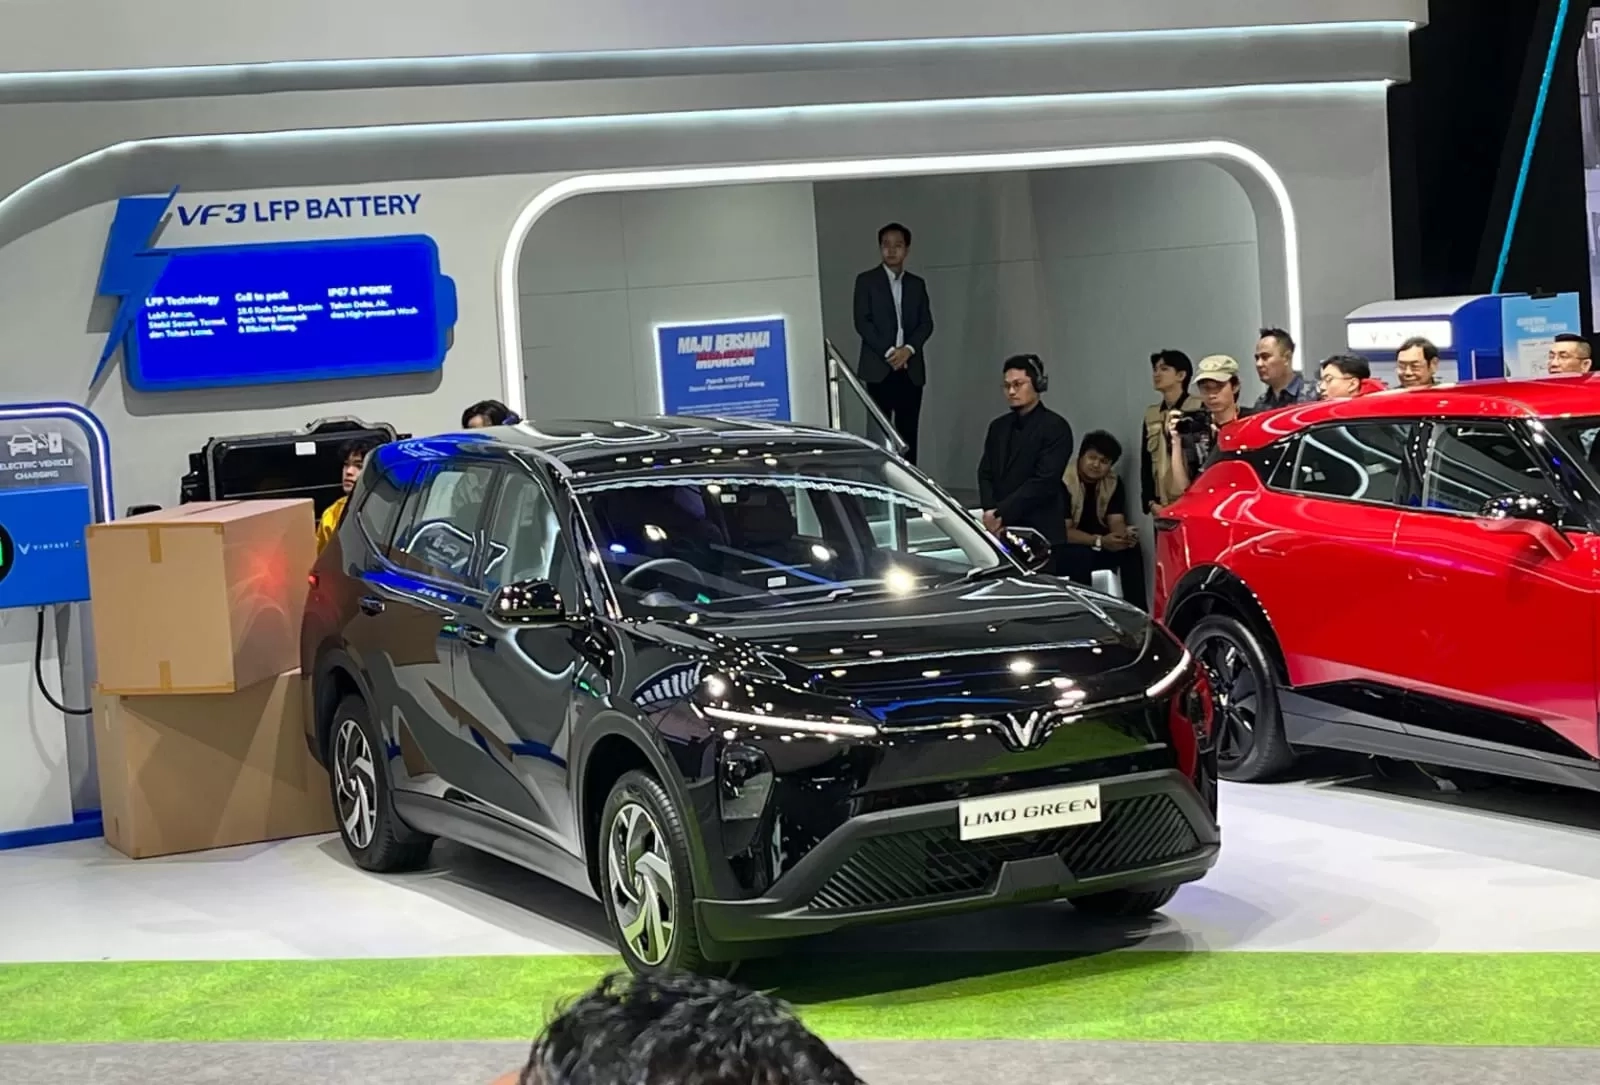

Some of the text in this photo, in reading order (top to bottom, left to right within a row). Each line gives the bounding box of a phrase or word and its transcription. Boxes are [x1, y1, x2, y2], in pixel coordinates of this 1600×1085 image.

[177, 193, 421, 226] VF3 LFP BATTERY
[235, 292, 252, 302] Cell
[254, 293, 264, 301] to
[328, 287, 348, 297] IP67
[350, 287, 358, 296] &
[145, 294, 219, 307] LFP Technology
[678, 331, 769, 354] MAJU BERSAMA
[39, 458, 73, 467] VEHICLE
[15, 470, 58, 480] CHARGING
[964, 798, 1098, 827] LIMO GREEN
